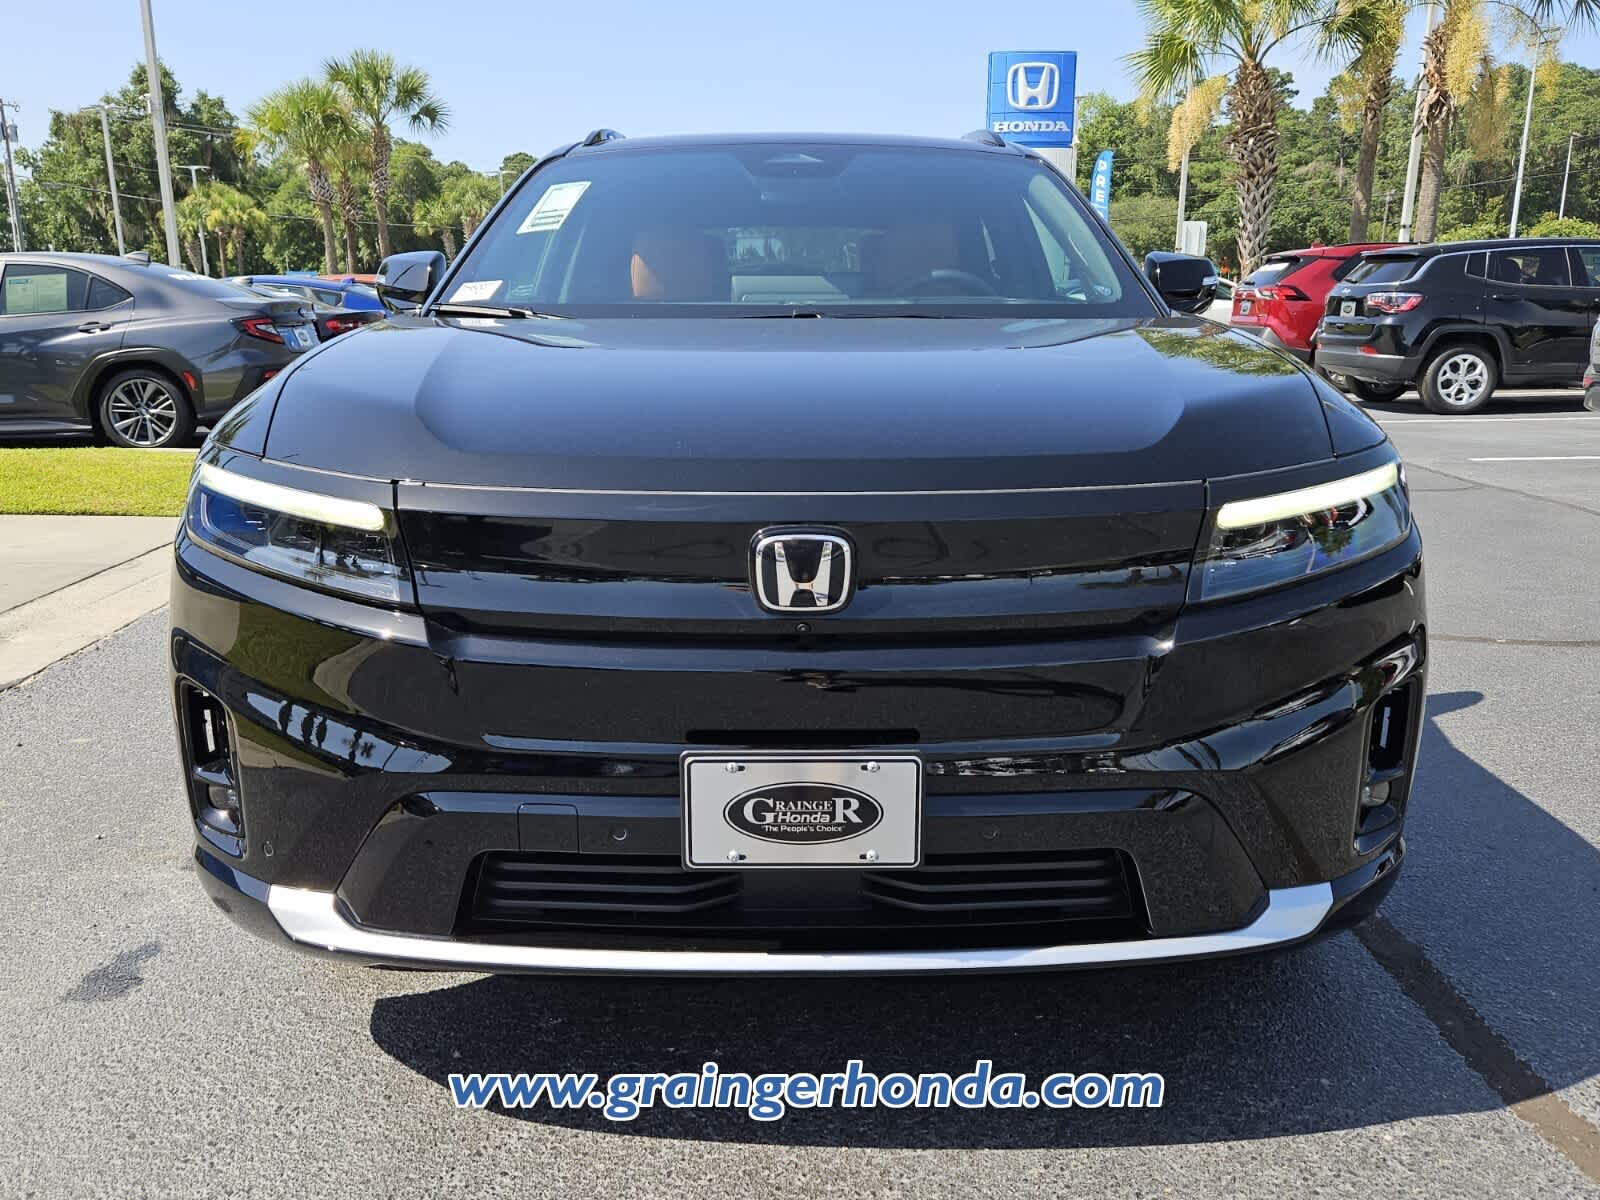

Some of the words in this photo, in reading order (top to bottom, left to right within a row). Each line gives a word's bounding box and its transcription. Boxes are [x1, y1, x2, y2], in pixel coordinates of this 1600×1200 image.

[993, 121, 1070, 132] HONDA
[743, 797, 863, 825] GRAINGER
[777, 811, 831, 823] Honda
[780, 825, 815, 834] People's
